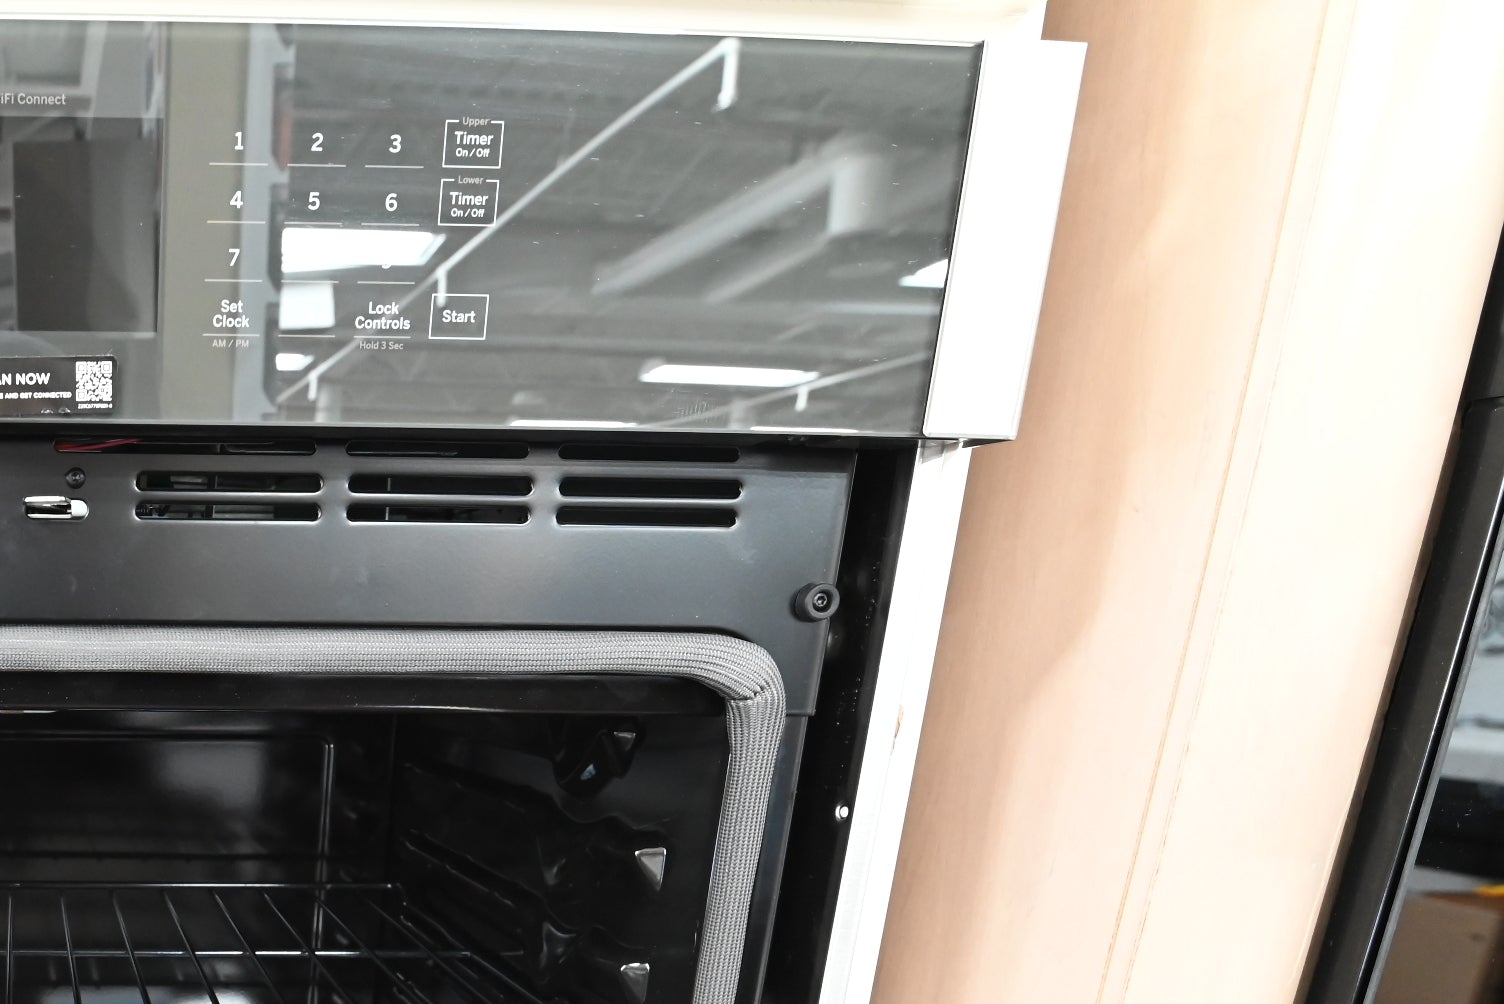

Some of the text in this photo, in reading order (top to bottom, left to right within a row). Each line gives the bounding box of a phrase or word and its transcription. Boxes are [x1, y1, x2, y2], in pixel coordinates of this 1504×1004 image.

[17, 93, 66, 105] Connect
[462, 117, 489, 127] Upper
[234, 131, 244, 150] 1
[310, 133, 324, 152] 2
[389, 134, 402, 153] 3
[454, 131, 494, 146] Timer
[457, 176, 484, 185] Lower
[229, 191, 244, 209] 4
[308, 192, 321, 210] 5
[385, 193, 398, 212] 6
[450, 191, 489, 206] Timer
[228, 248, 241, 267] 7
[220, 299, 244, 313] Set
[368, 301, 400, 315] Lock
[212, 314, 250, 328] Clock
[442, 308, 476, 323] Start
[354, 316, 411, 330] Controls
[212, 339, 225, 348] AM
[235, 339, 249, 348] PM
[359, 340, 404, 350] Hold 3 Sec
[15, 373, 51, 385] NOW
[33, 391, 72, 399] CONNECTED
